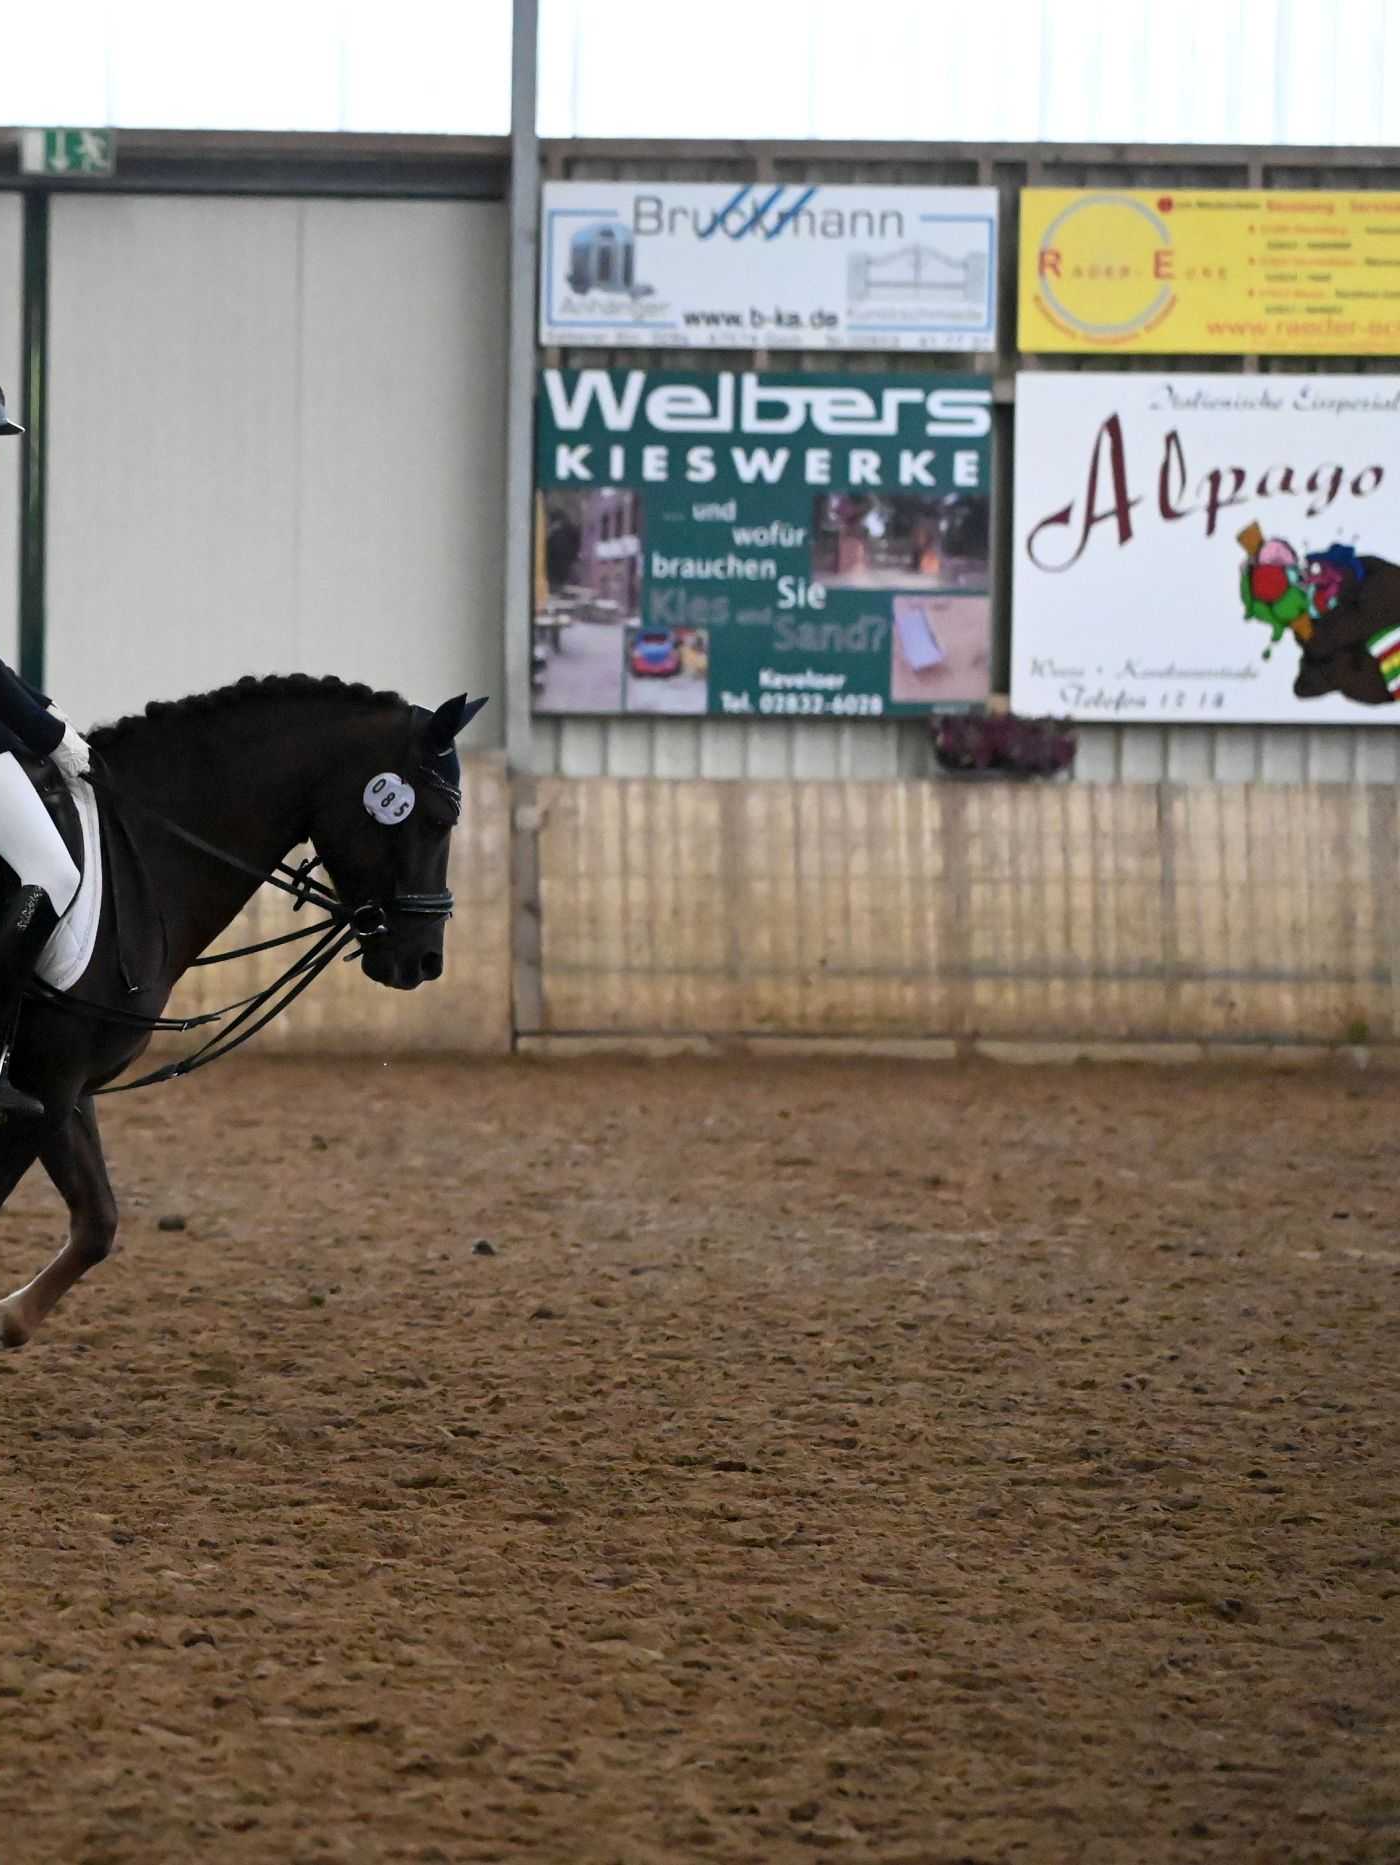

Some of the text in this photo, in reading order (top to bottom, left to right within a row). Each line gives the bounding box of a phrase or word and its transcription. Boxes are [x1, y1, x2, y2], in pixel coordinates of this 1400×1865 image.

[542, 369, 993, 438] Welbers
[554, 443, 981, 488] KIESWERKE
[1026, 410, 1385, 574] Alpago
[692, 500, 737, 523] und
[731, 520, 808, 548] wofür
[651, 552, 778, 581] brauchen
[650, 588, 731, 626] Kies
[777, 576, 827, 611] Sie
[773, 613, 888, 654] Sand?
[372, 778, 410, 817] 085
